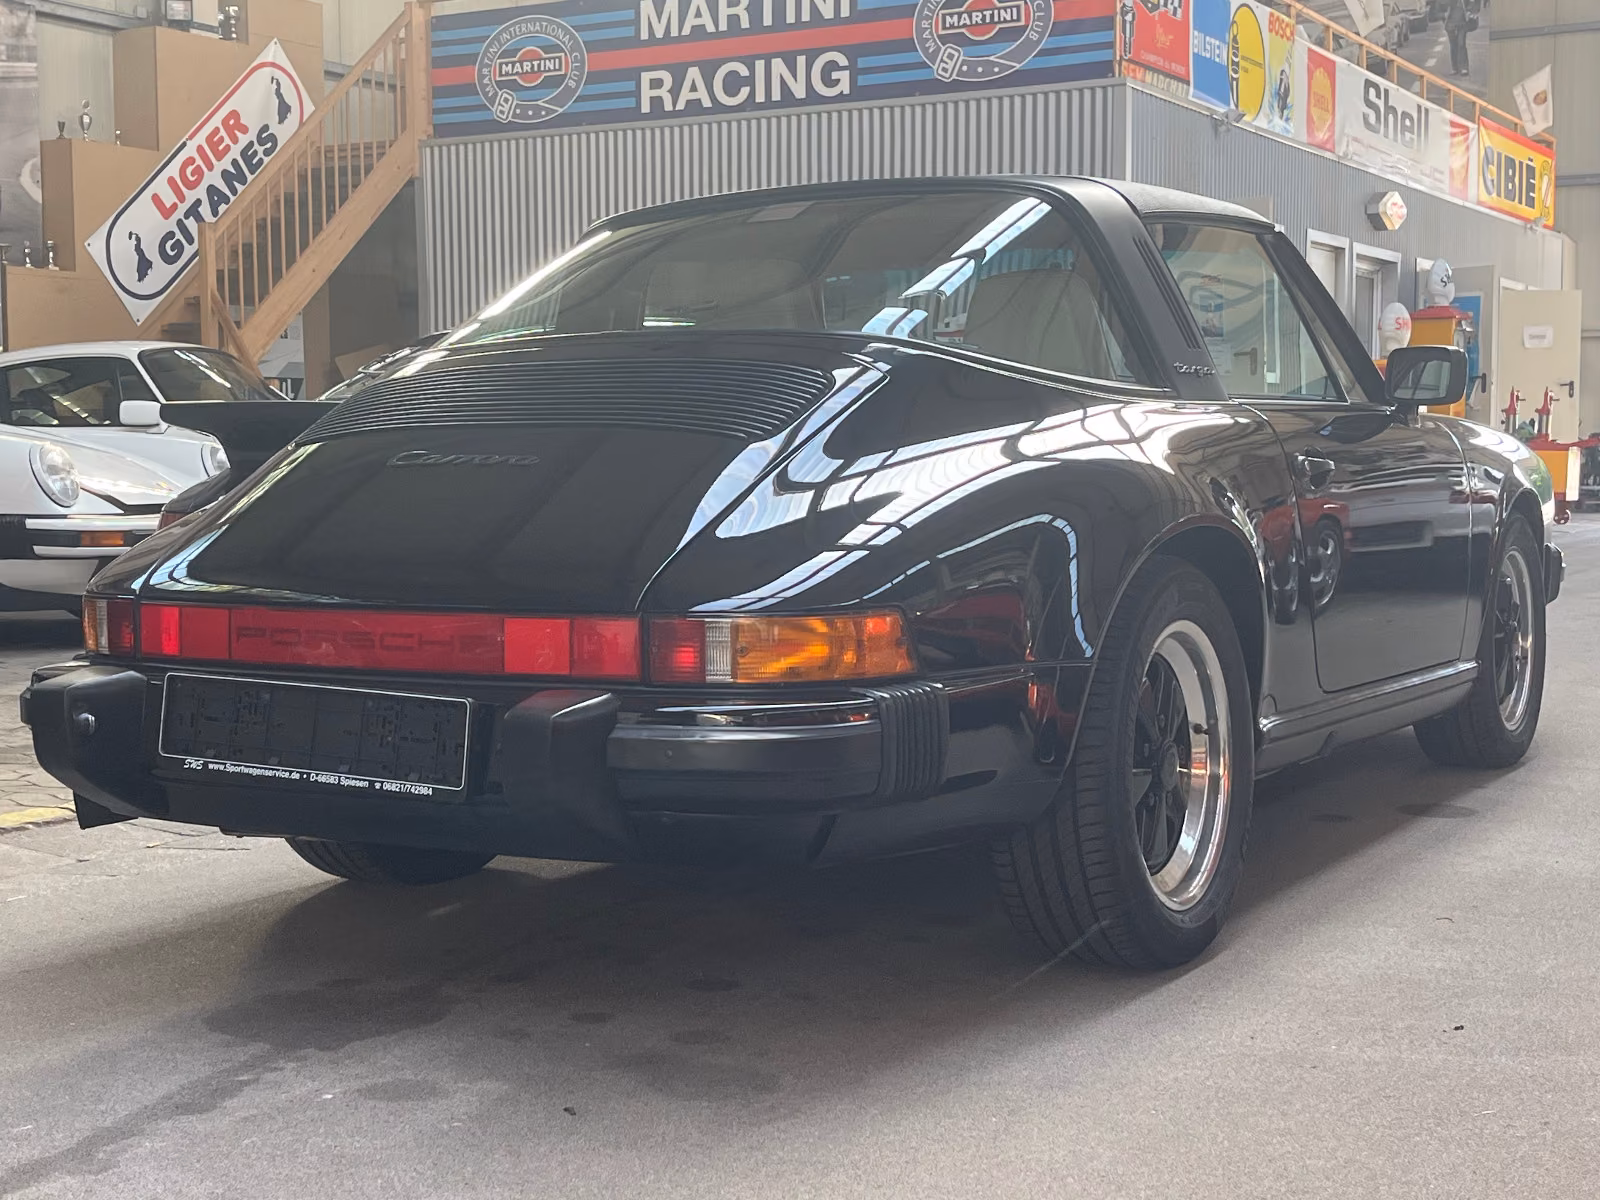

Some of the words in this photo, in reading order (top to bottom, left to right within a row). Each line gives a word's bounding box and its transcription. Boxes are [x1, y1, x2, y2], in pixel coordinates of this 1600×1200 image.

[945, 7, 1018, 28] MARTINI
[1029, 0, 1045, 41] CLUB
[1268, 11, 1296, 41] BOSCH
[482, 42, 500, 97] MARTINI
[500, 21, 574, 51] INTERNATIONAL
[568, 52, 581, 88] CLUB
[501, 58, 560, 75] MARTINI
[1193, 30, 1228, 67] BILSTEIN
[640, 51, 850, 114] RACING
[1362, 78, 1430, 152] Shell
[151, 109, 249, 220] LIGIER
[158, 123, 279, 265] GITANES
[236, 625, 499, 654] PORSCHE
[208, 762, 301, 780] www.Sportwagenservice.de
[309, 773, 339, 785] D-66583
[382, 781, 433, 796] 06821/742984
